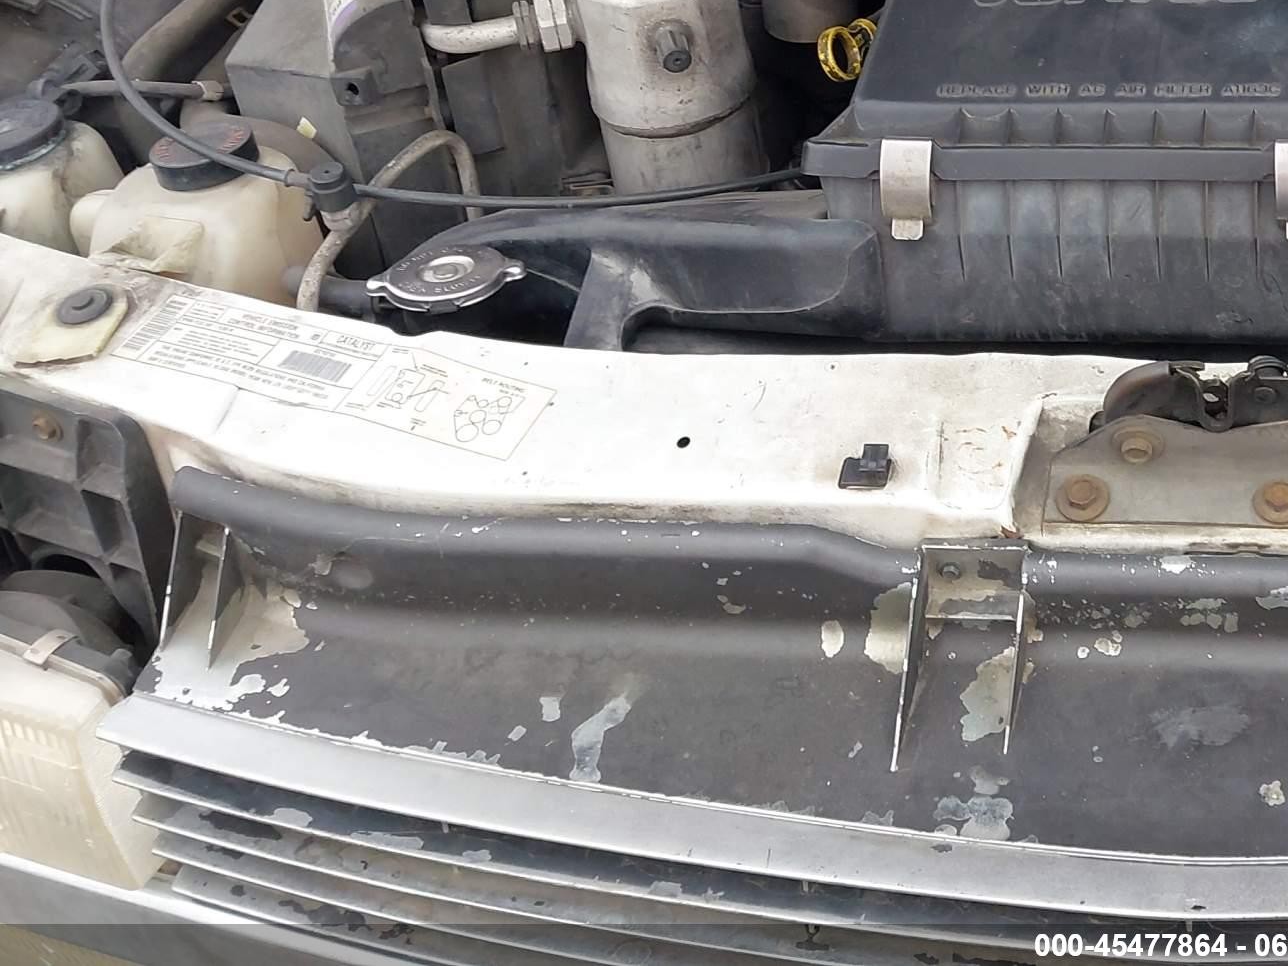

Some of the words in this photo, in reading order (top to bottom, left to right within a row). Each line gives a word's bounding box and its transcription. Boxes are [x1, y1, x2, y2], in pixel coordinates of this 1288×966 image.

[936, 83, 1017, 98] REPLACE
[1025, 83, 1071, 98] WITH
[1077, 83, 1106, 98] AC
[1114, 83, 1147, 98] AIR
[1153, 83, 1213, 98] FILTER
[336, 334, 376, 351] CATALYST
